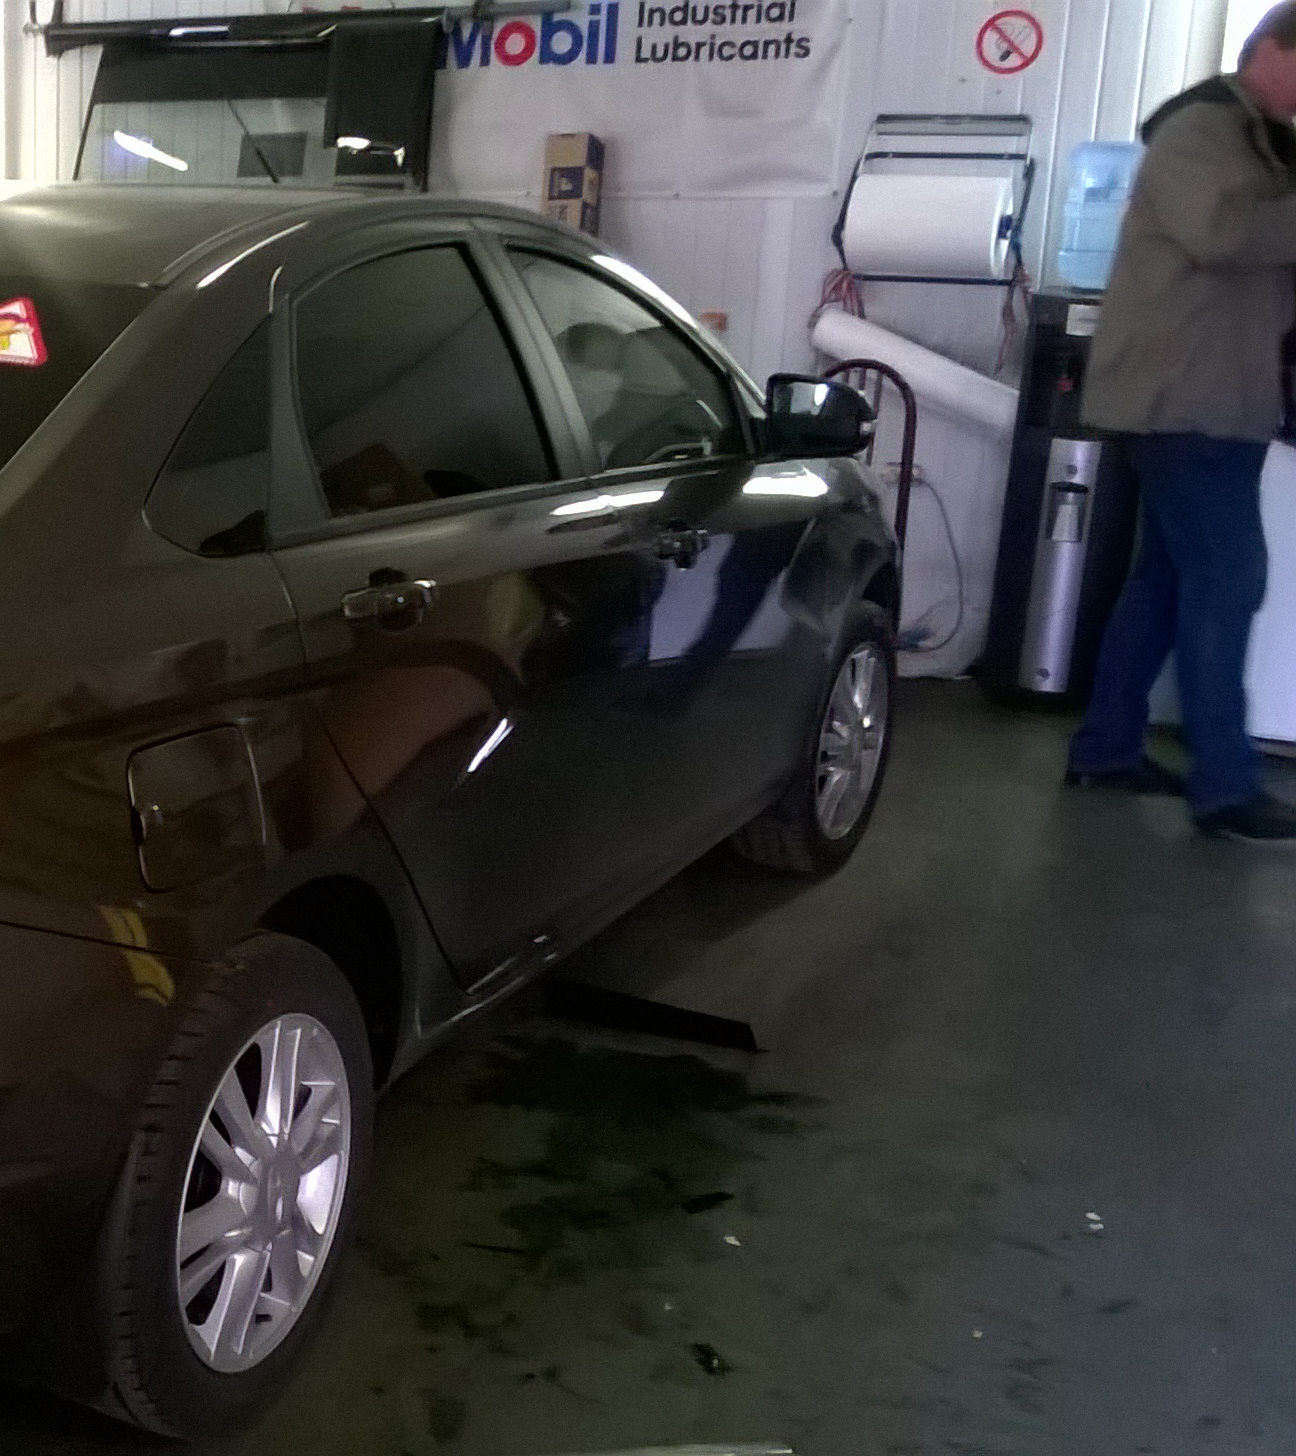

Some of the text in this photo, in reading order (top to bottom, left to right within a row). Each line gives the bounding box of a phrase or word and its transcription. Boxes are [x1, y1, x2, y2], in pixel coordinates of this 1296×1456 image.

[637, 0, 796, 28] Industrial
[437, 3, 619, 69] Mobil
[635, 31, 811, 64] Lubricants
